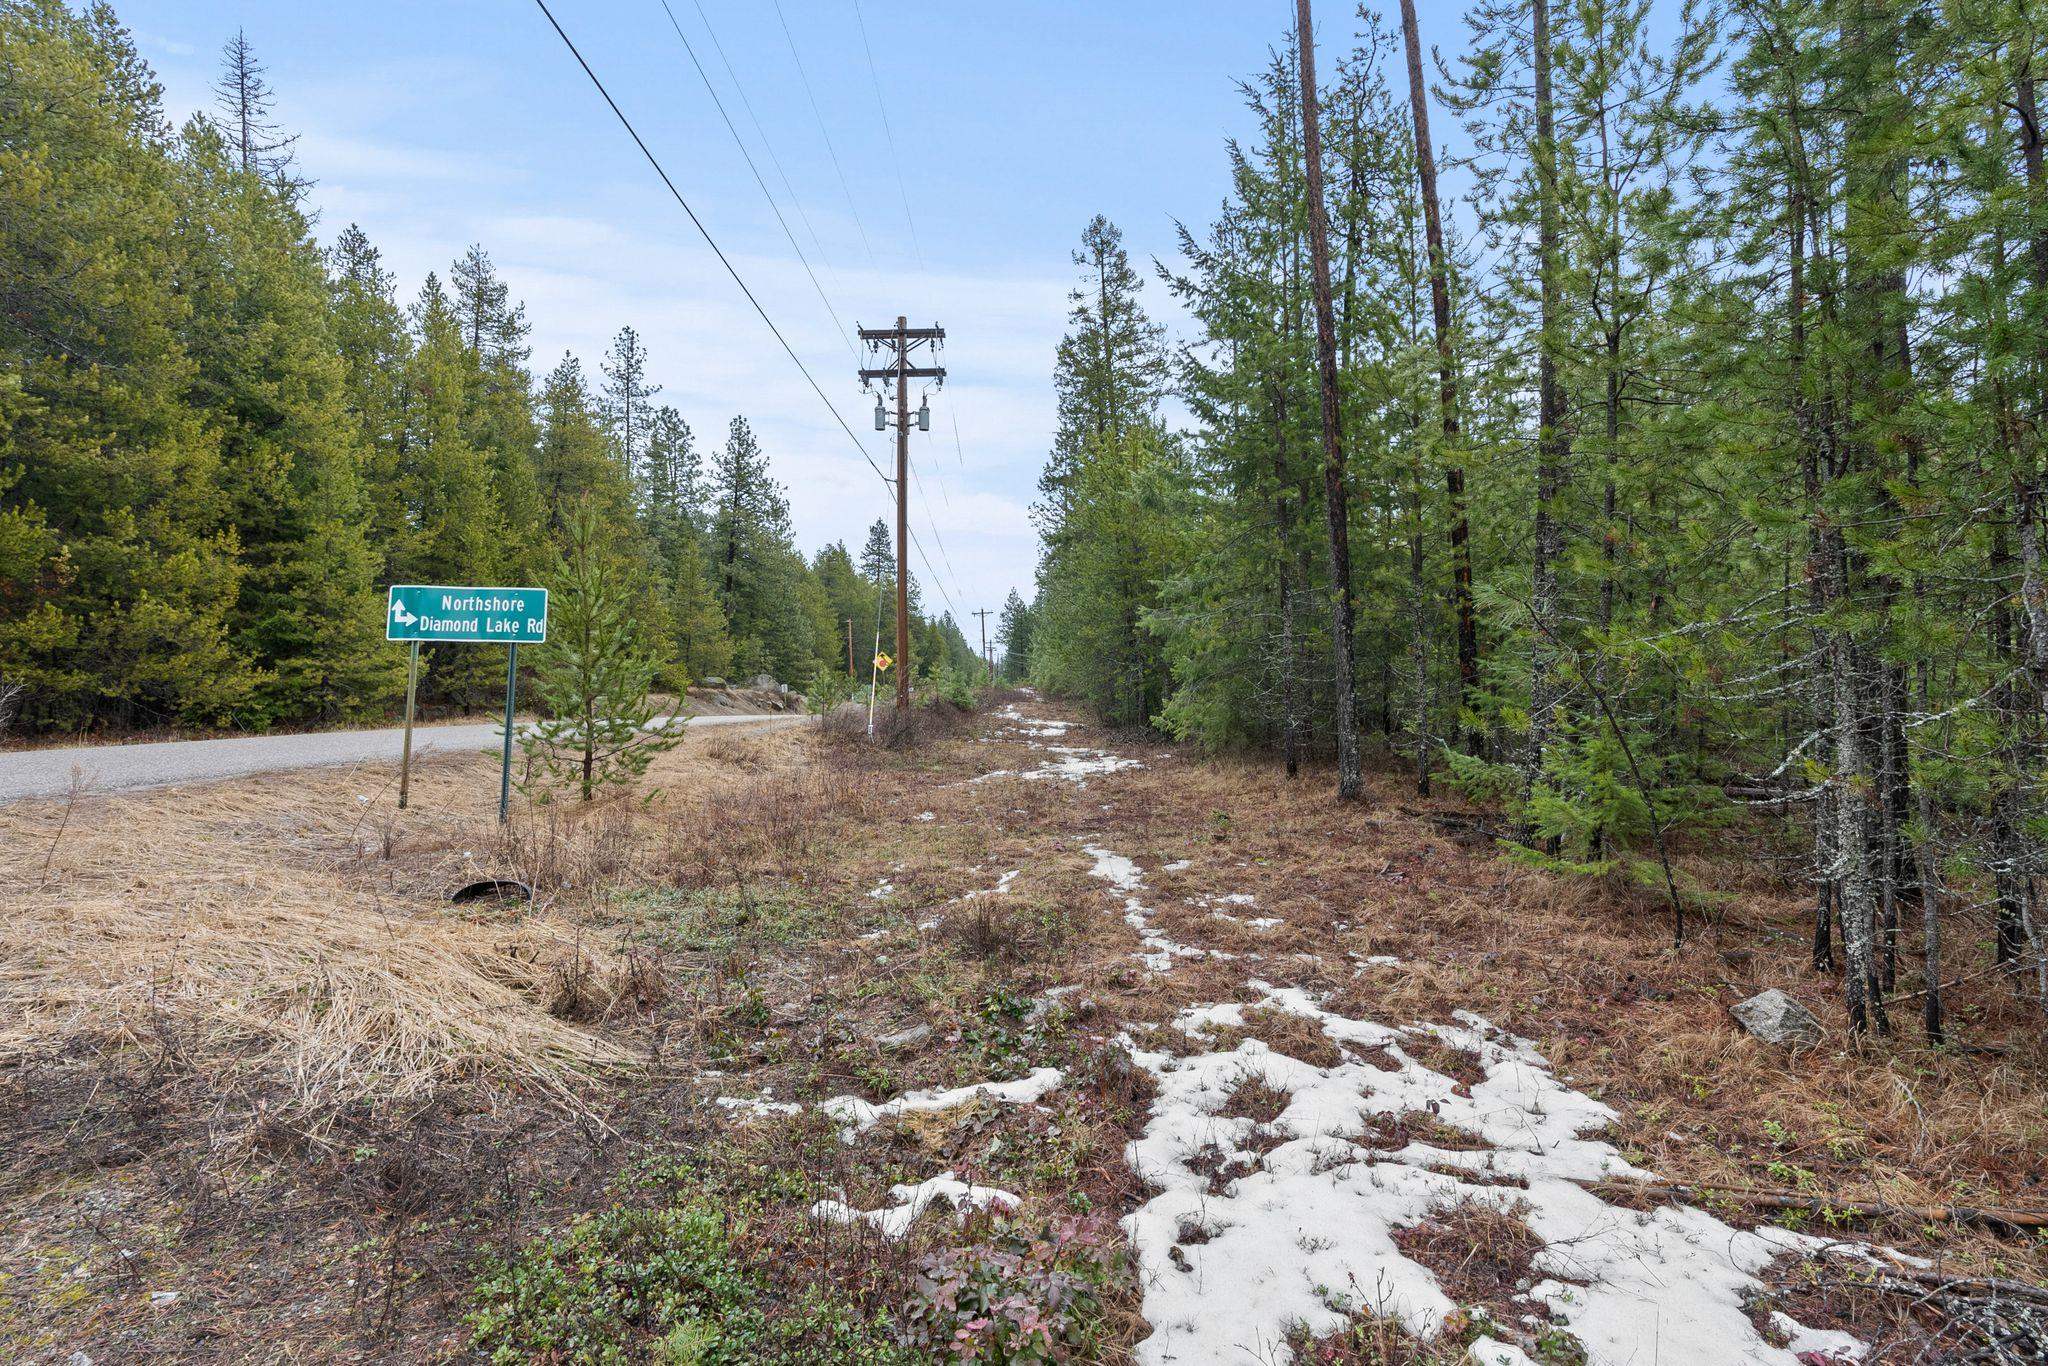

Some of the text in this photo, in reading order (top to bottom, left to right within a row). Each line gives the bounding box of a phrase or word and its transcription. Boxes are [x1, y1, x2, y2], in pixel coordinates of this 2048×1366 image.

[442, 595, 524, 612] Northshore
[420, 616, 544, 634] Diamond Lake Rd
